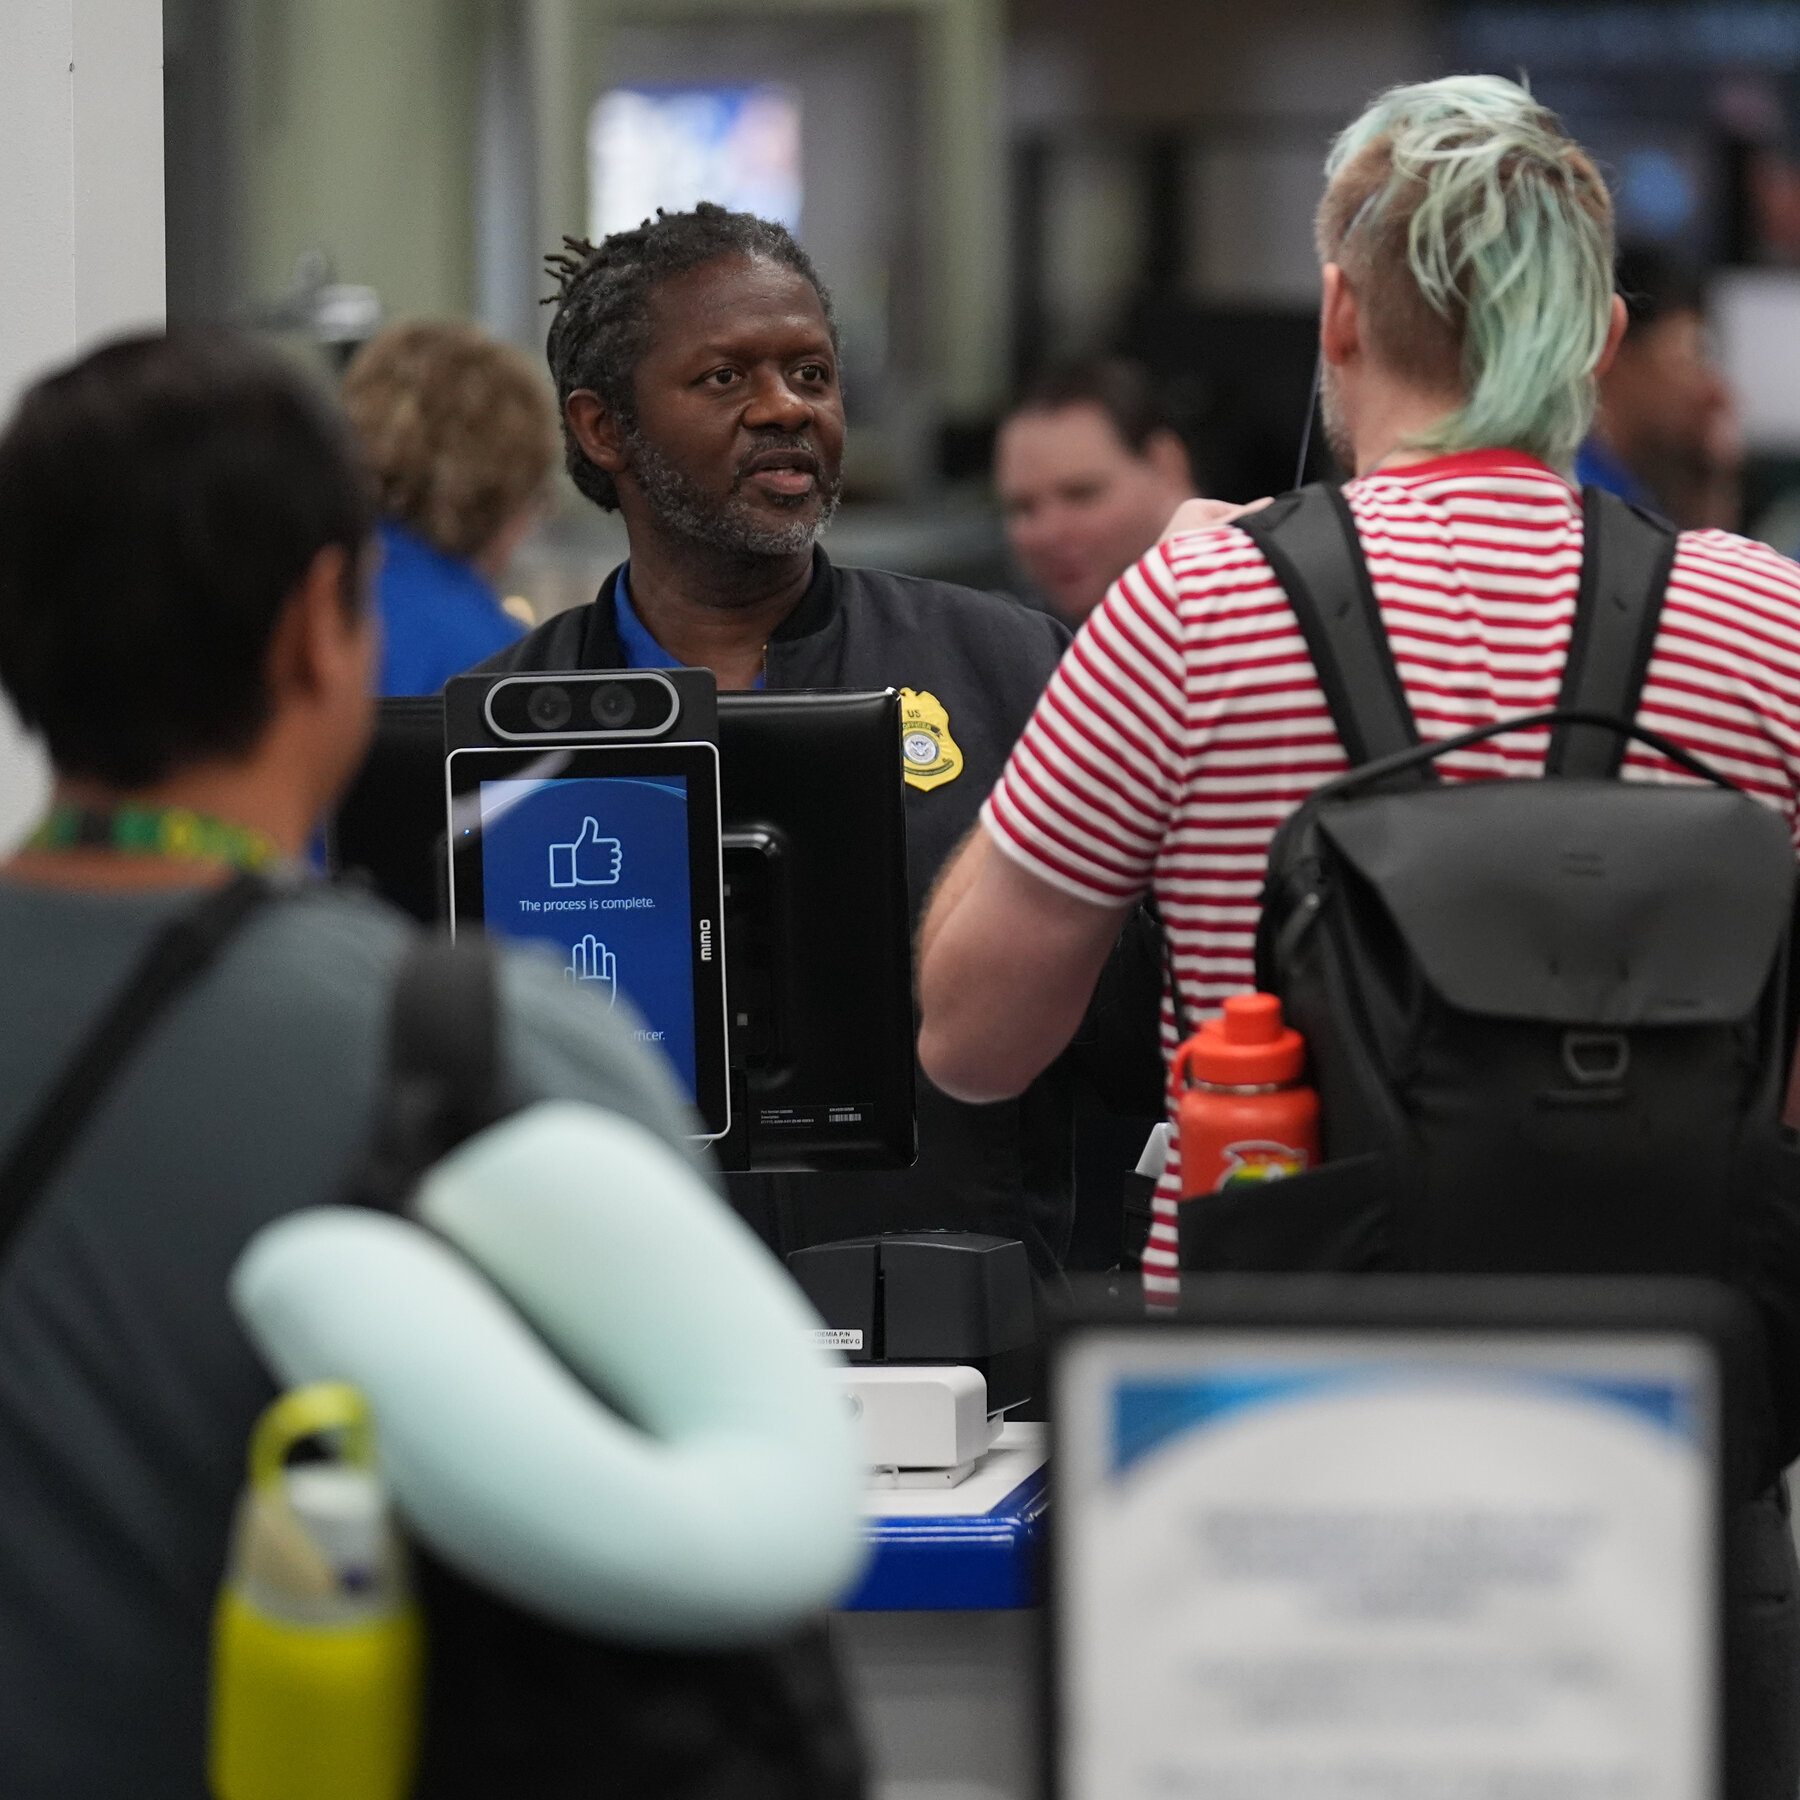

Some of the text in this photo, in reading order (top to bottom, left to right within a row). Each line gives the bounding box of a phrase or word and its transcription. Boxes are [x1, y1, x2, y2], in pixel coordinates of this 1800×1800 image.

[907, 709, 921, 718] US
[520, 896, 656, 912] The process is complete.
[700, 919, 712, 961] mimo
[626, 1029, 666, 1041] fficer.
